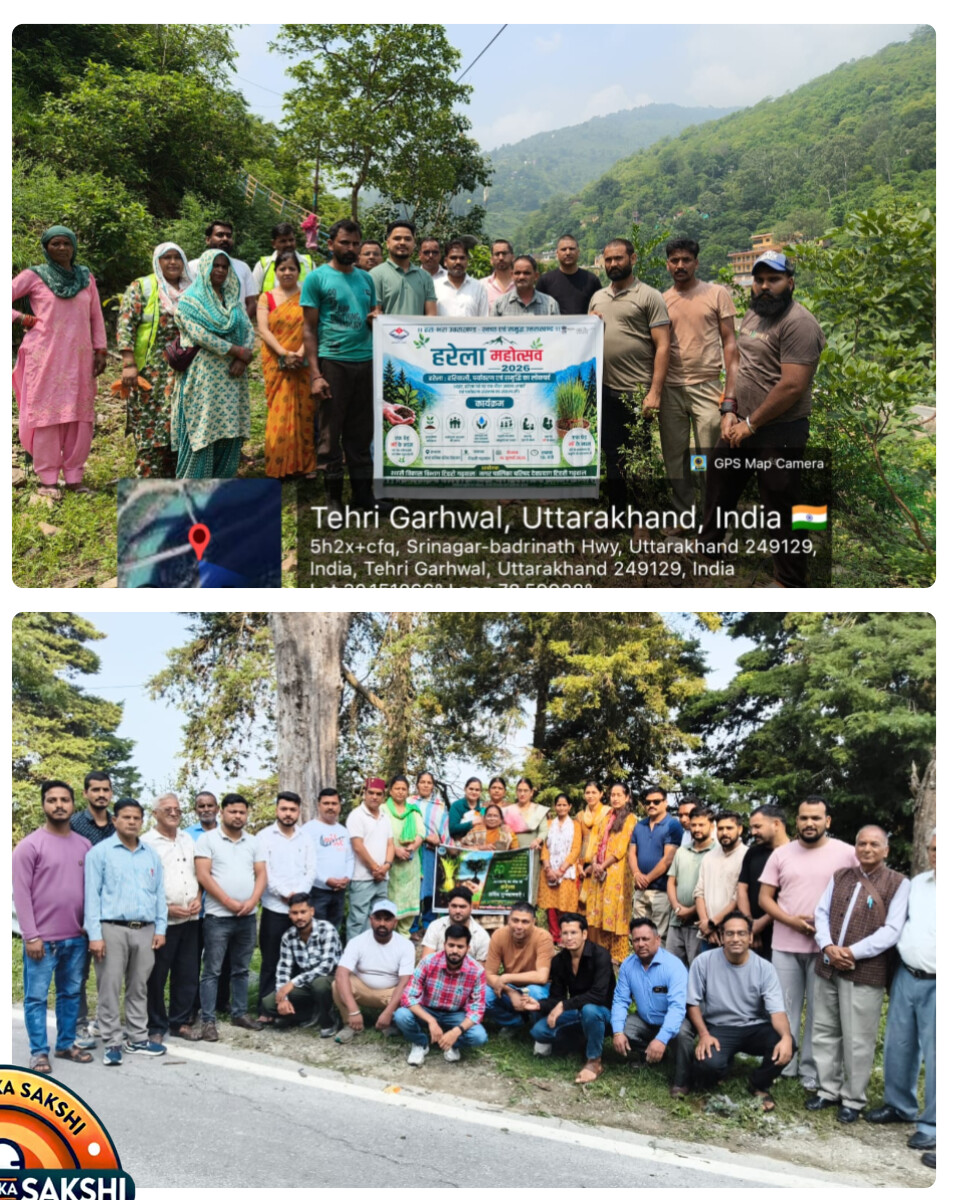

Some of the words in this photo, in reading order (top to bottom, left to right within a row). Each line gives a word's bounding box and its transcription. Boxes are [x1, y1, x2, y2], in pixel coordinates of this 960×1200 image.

[430, 343, 487, 366] हरेला
[489, 346, 544, 362] महोत्सव
[474, 399, 504, 408] कार्यक्रम
